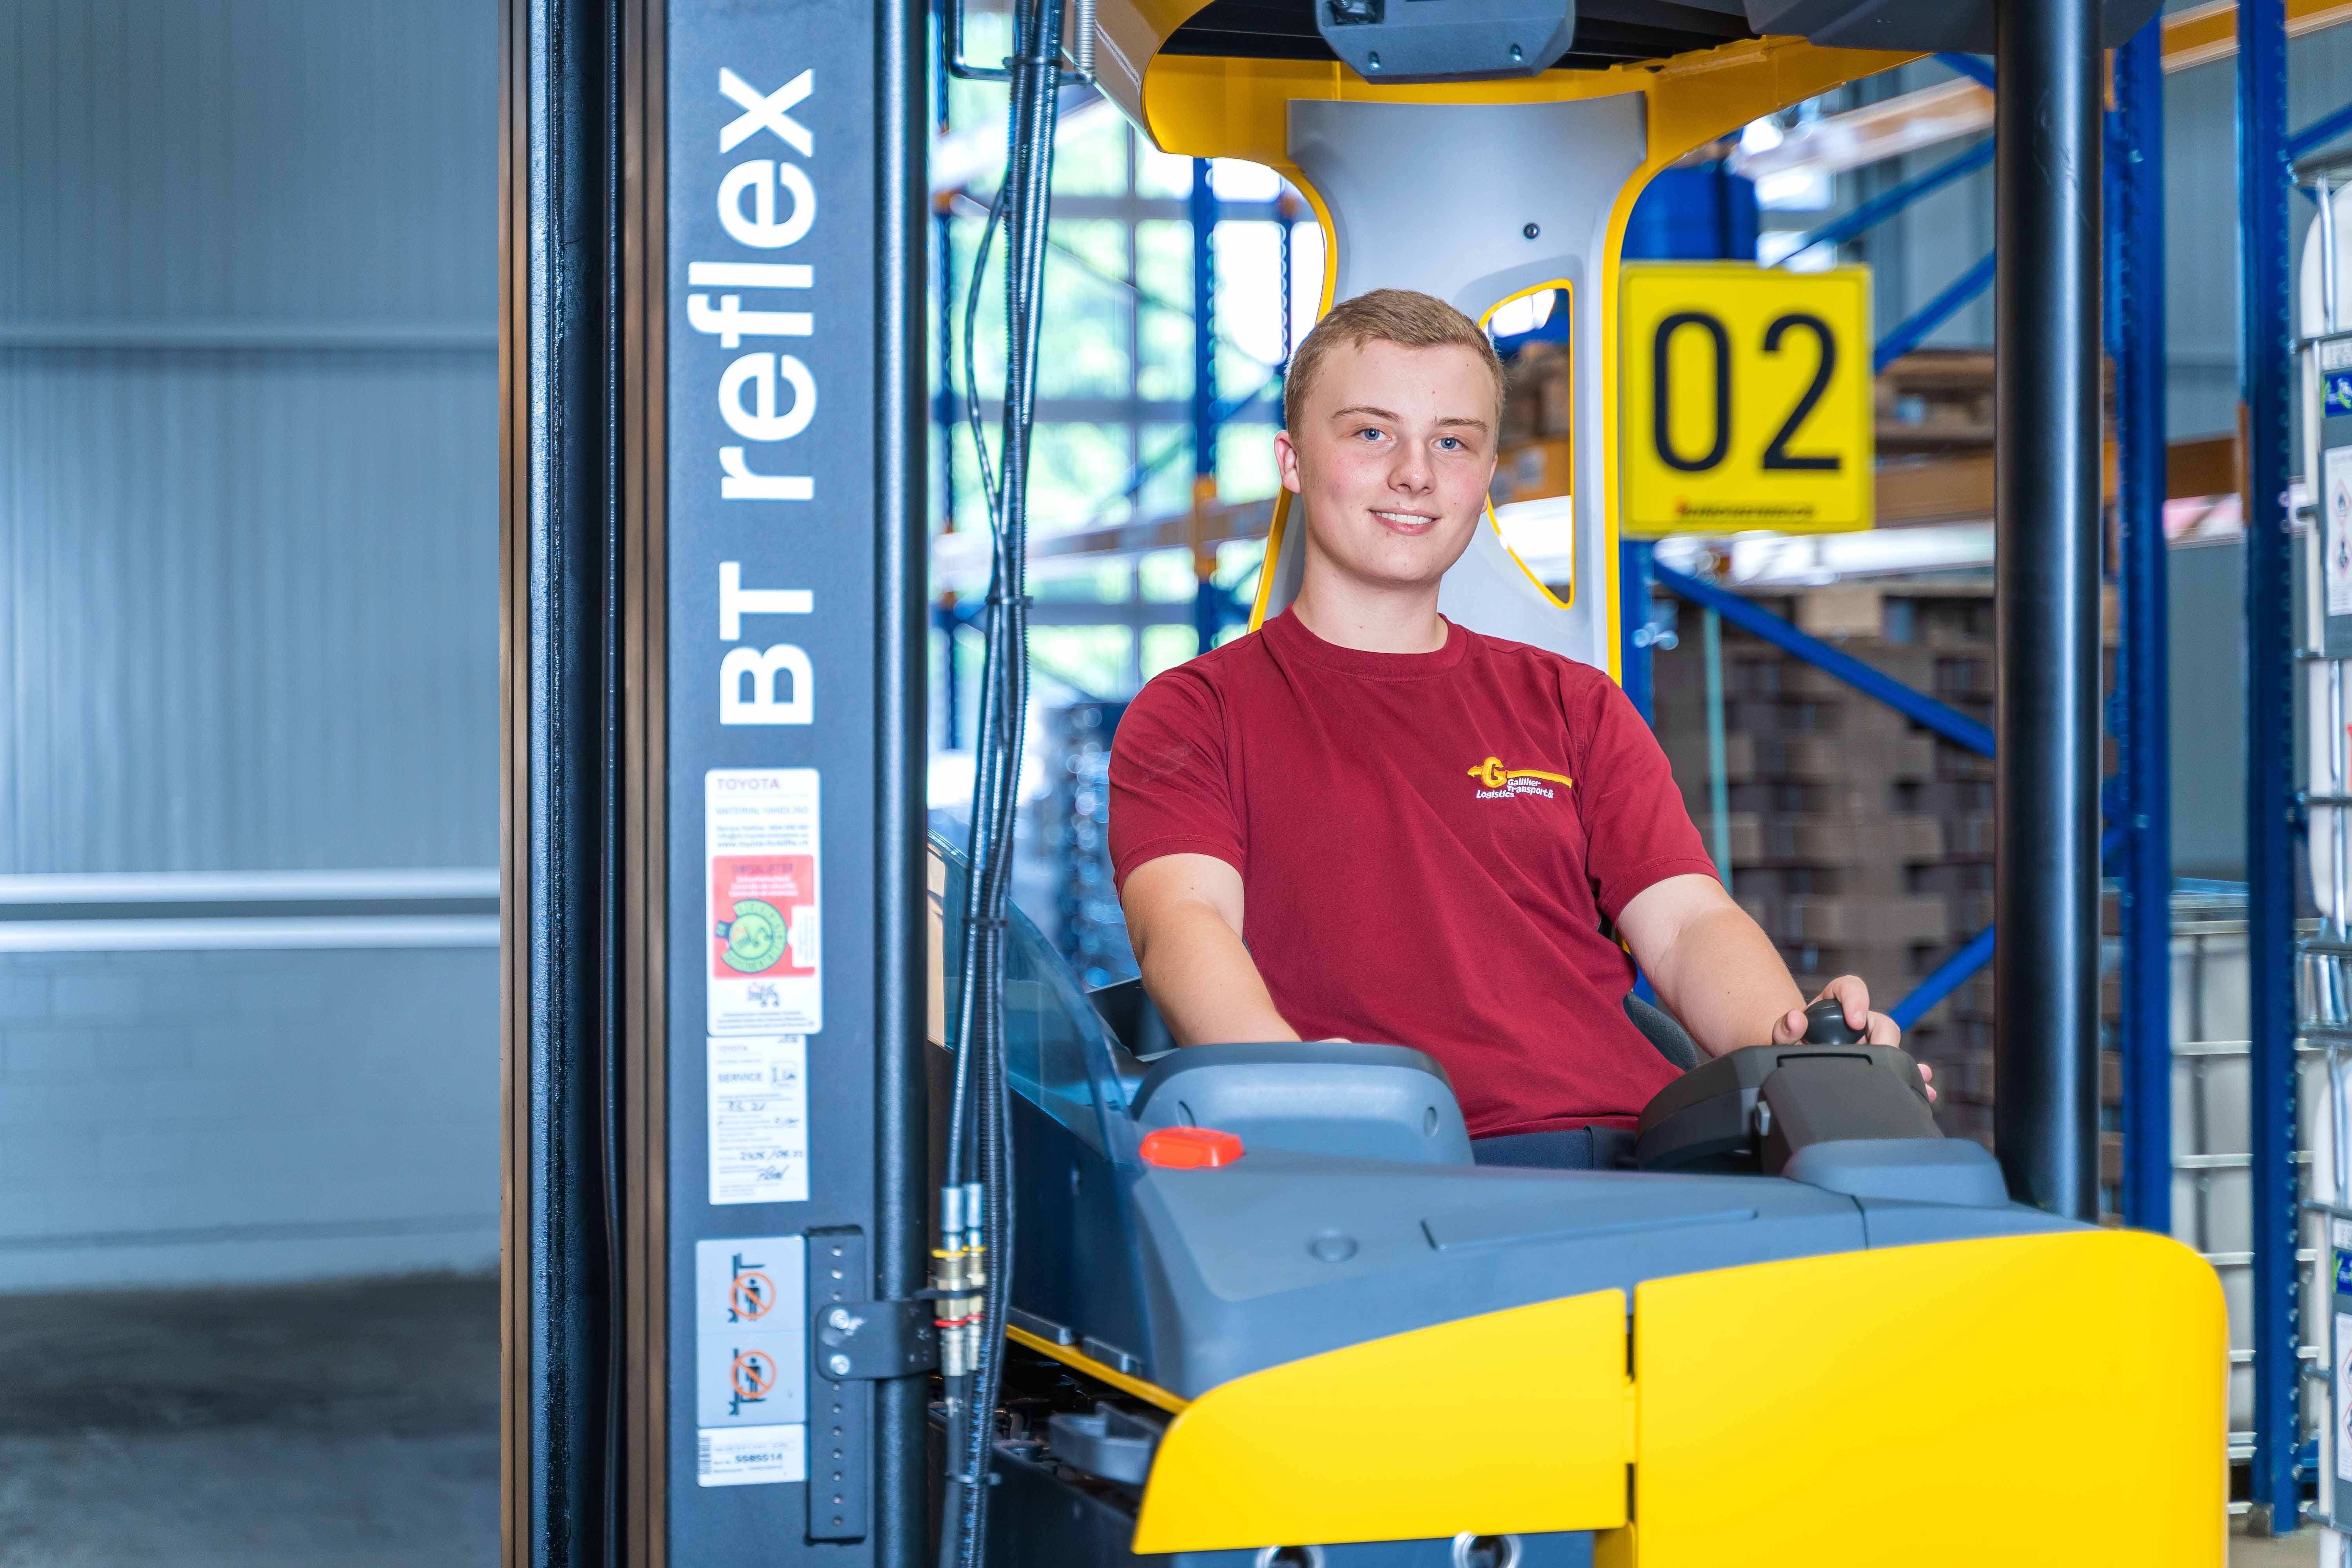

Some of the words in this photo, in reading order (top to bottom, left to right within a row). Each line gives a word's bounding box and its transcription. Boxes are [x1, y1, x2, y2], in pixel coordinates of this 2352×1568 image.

[687, 67, 817, 500] reflex
[1652, 311, 1841, 472] 02
[719, 562, 813, 725] BT
[717, 778, 780, 790] TOYOTA
[1476, 789, 1515, 799] Logistics
[718, 1073, 762, 1083] SERVICE
